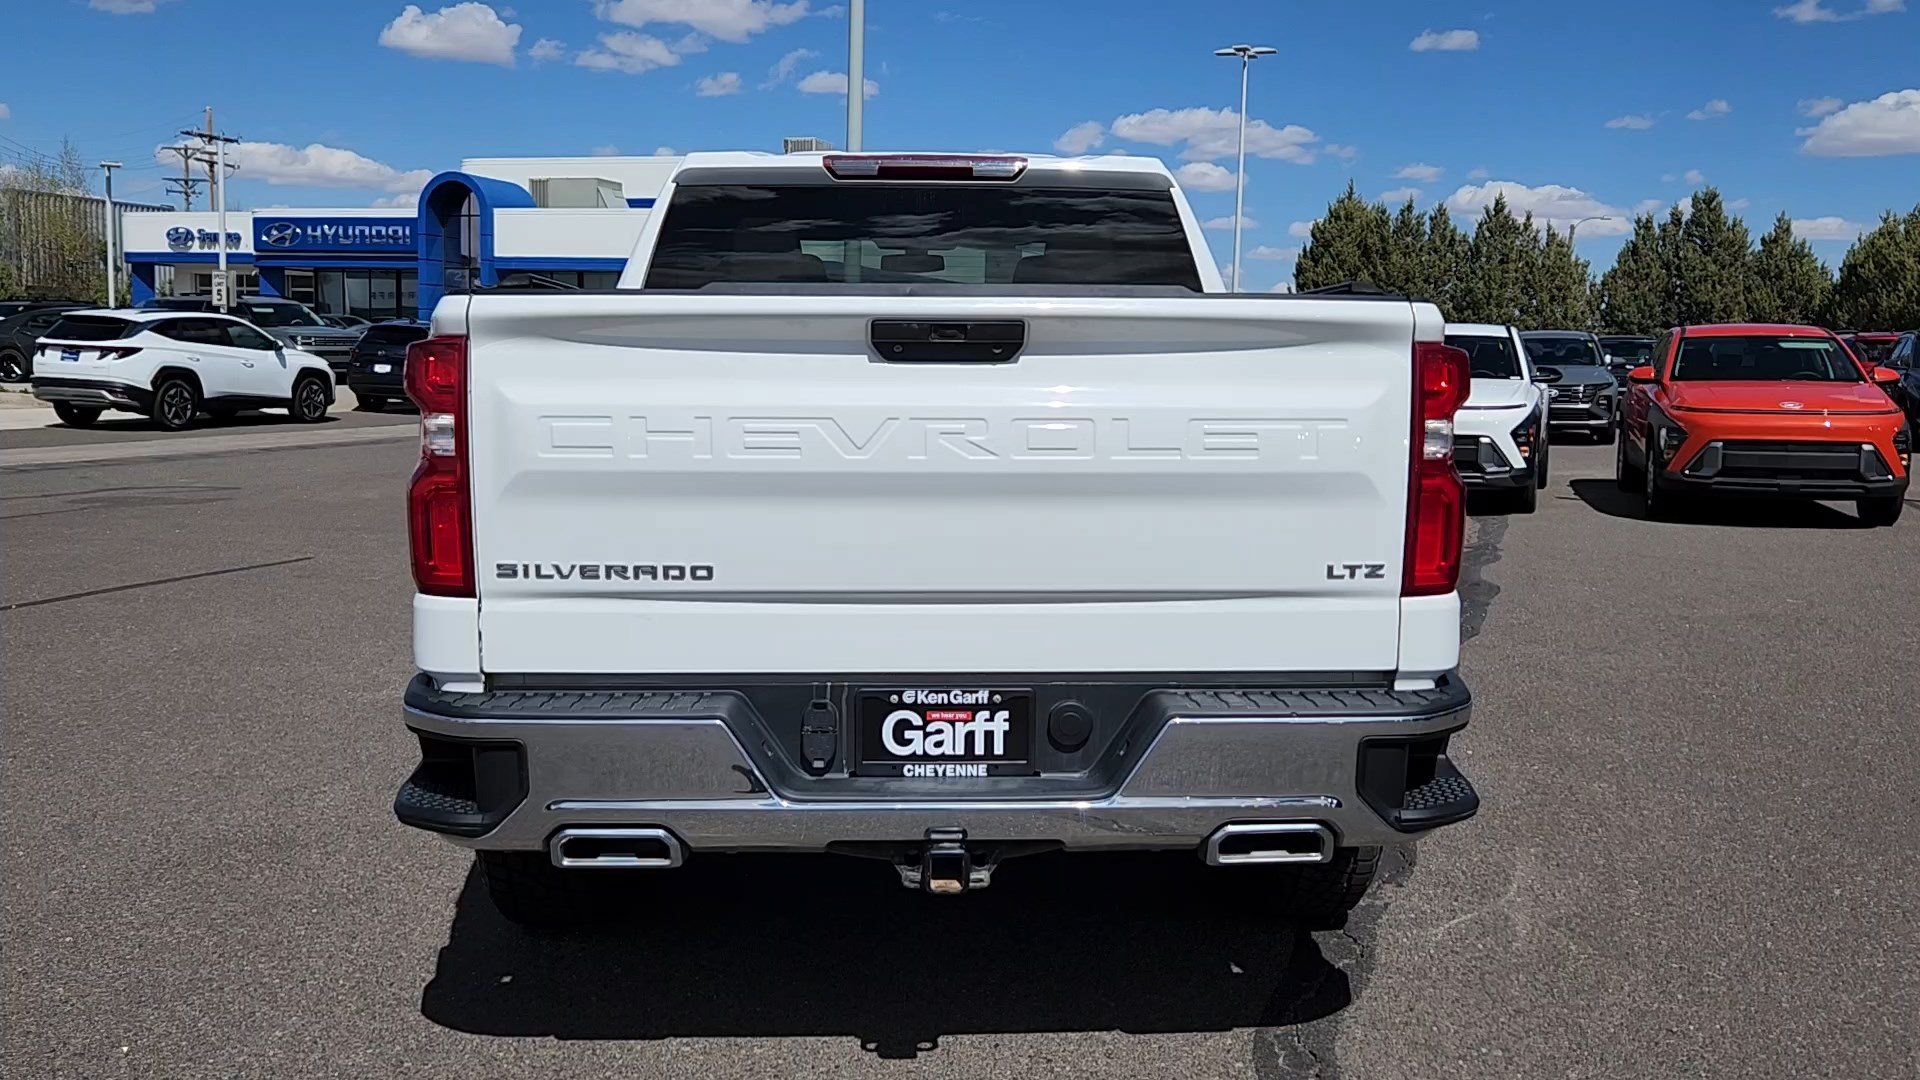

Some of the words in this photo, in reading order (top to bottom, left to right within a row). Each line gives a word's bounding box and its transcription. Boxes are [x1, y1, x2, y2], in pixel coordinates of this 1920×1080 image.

[307, 225, 411, 245] HYUNDAI
[216, 288, 223, 302] 5
[537, 415, 1349, 460] CHEVROLET
[496, 563, 714, 581] SILVERADO
[1326, 564, 1385, 579] LTZ
[917, 690, 948, 704] Ken
[949, 690, 989, 704] Garff
[882, 709, 1010, 756] Garff
[903, 764, 988, 777] CHEYENNE
